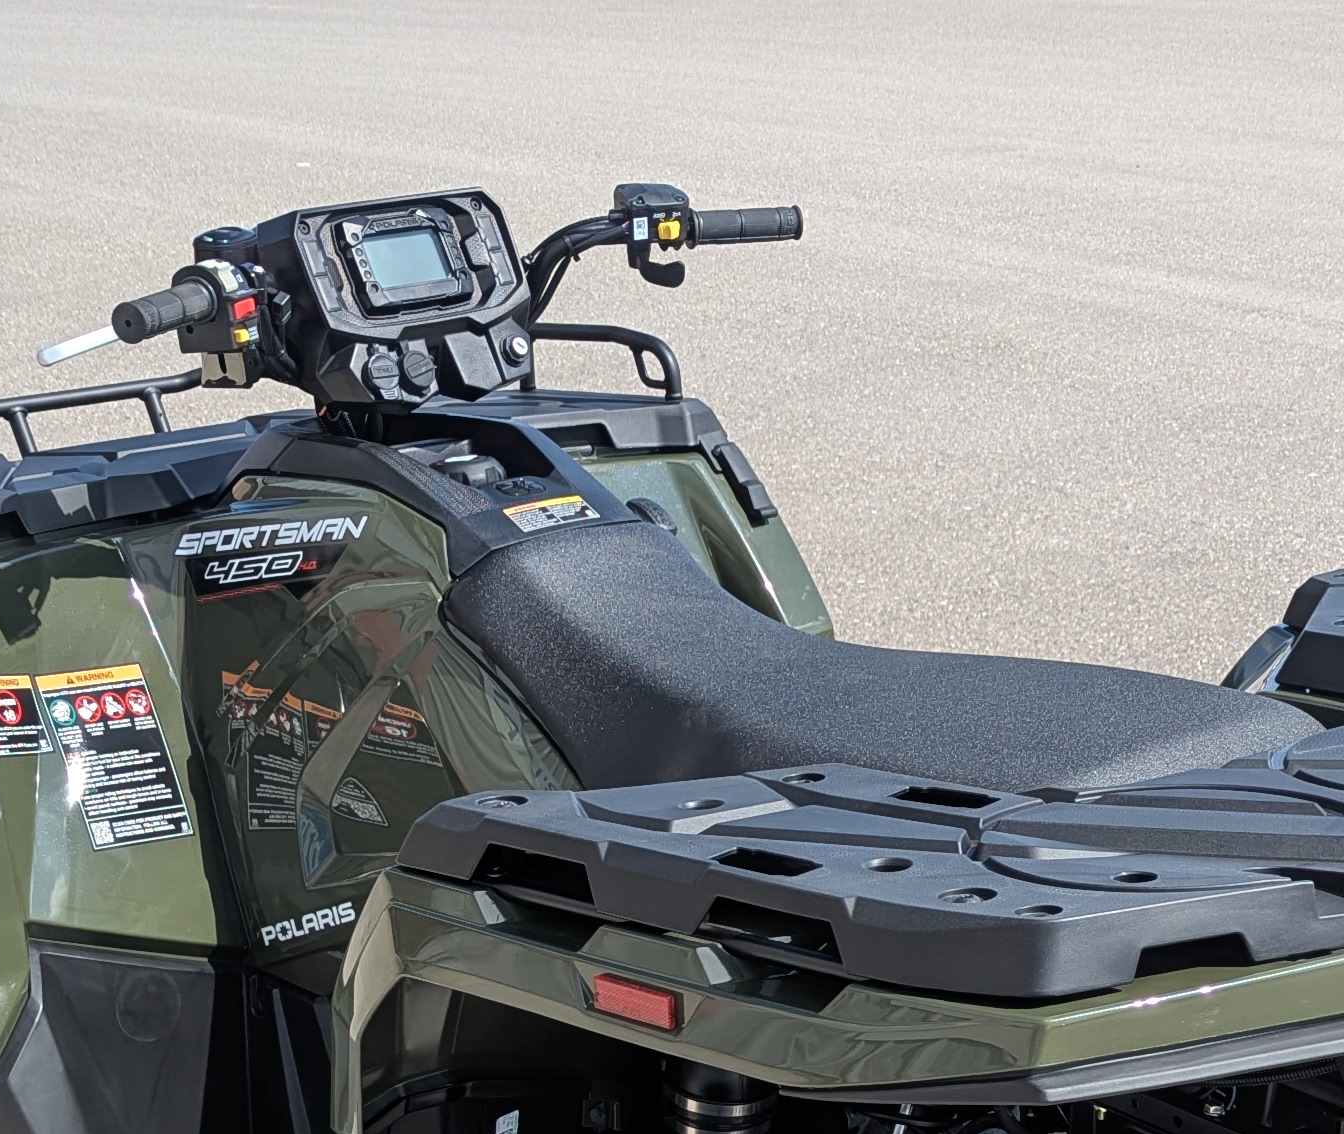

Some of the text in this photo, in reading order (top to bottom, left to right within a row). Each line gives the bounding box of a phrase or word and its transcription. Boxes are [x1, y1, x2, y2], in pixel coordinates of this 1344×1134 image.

[174, 515, 369, 556] SPORTSMAN
[204, 551, 303, 584] 450
[75, 671, 115, 683] WARNING
[260, 901, 356, 946] POLARIS
